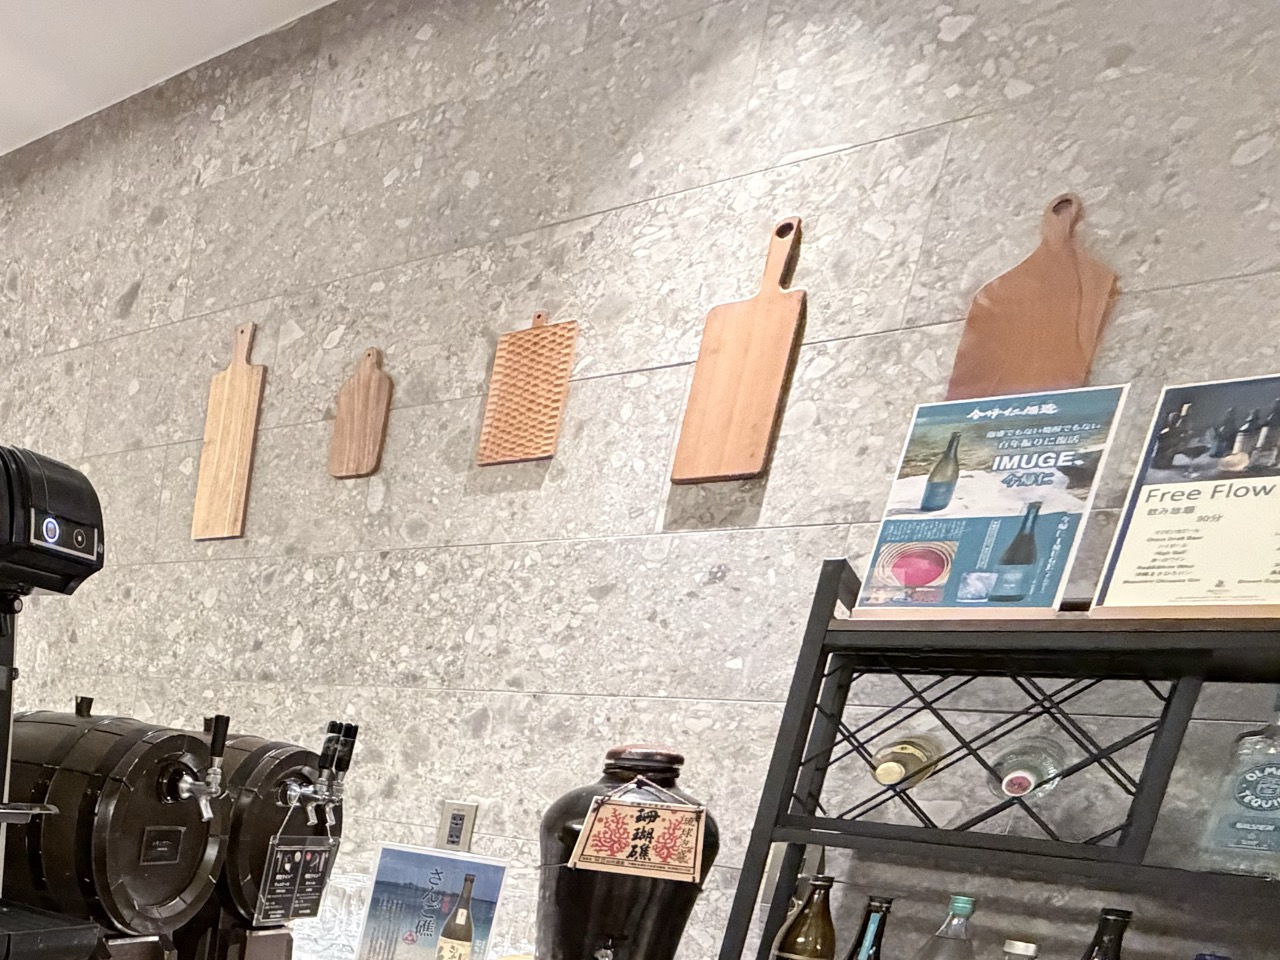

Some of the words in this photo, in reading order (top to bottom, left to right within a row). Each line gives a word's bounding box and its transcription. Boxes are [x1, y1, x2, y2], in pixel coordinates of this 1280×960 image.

[1145, 488, 1202, 504] Free
[1210, 483, 1278, 500] Flow
[626, 808, 661, 861] 珊瑚礁
[415, 868, 444, 937] さんご礁
